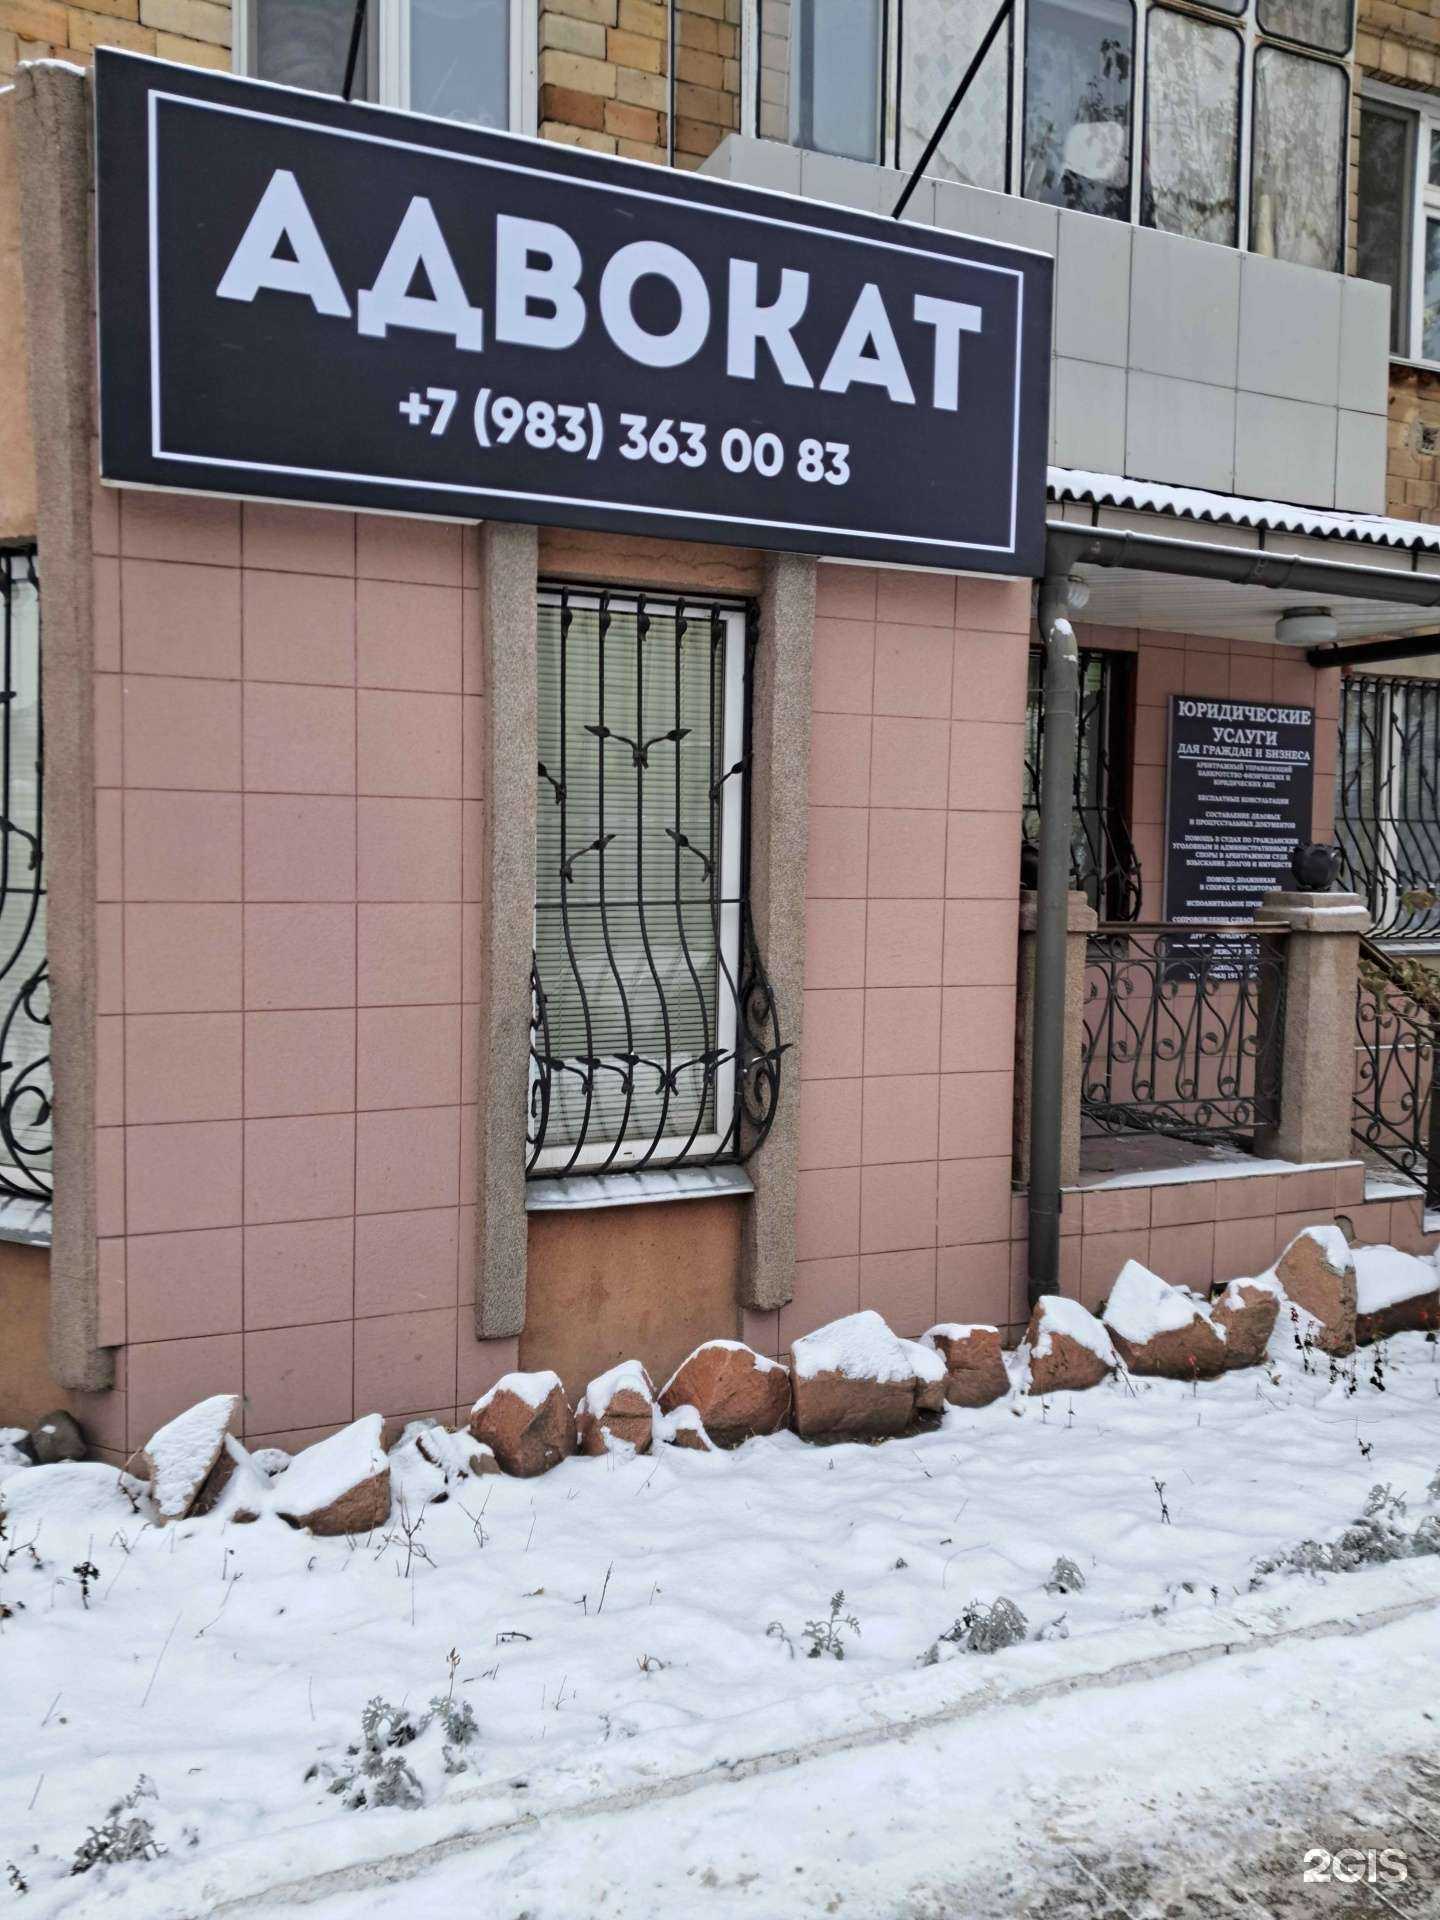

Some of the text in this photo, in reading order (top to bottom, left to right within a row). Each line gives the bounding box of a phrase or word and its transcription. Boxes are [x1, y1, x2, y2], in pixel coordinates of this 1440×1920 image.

[216, 169, 983, 411] АДВОКАТ
[399, 388, 851, 486] +7 (983) 363 00 83
[1178, 701, 1312, 725] ЮРИДИЧЕСКИЕ
[1212, 727, 1278, 746] УСЛУГИ
[1177, 744, 1310, 760] ДЛЯ ГРАЖДАН И БИЗНЕСА
